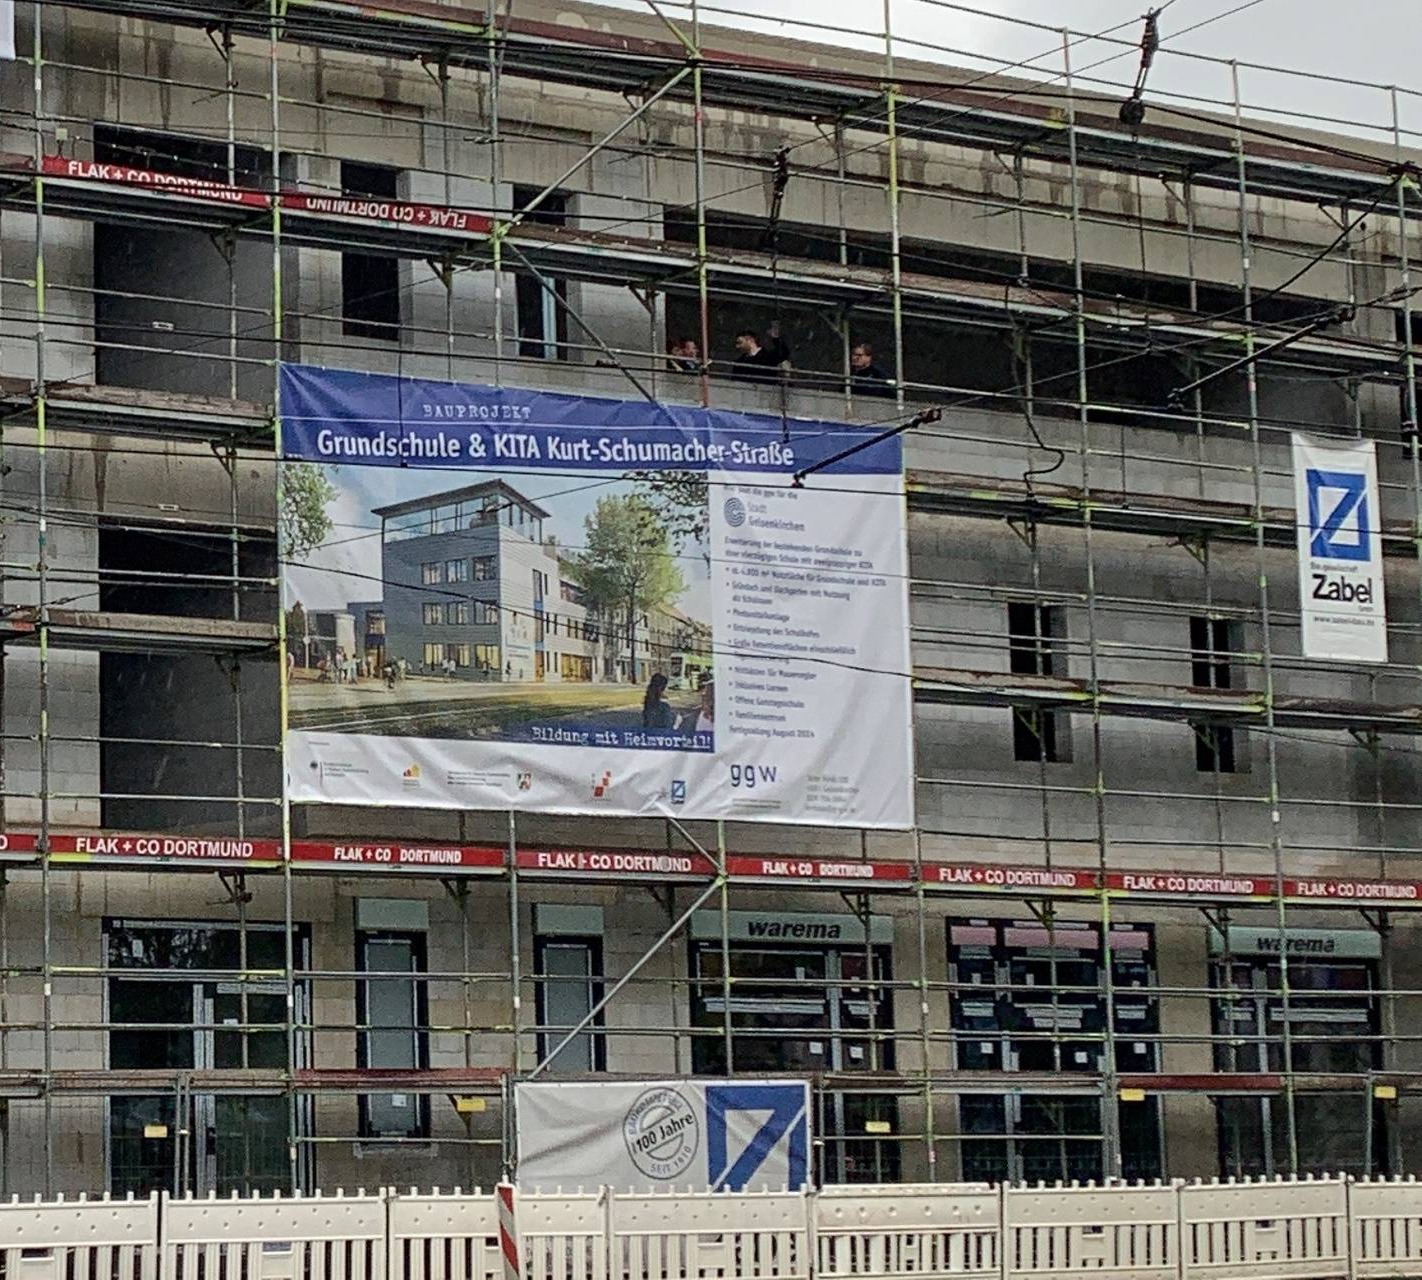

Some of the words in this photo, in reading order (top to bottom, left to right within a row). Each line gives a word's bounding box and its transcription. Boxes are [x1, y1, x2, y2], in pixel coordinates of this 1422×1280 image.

[68, 161, 109, 180] FLAK
[114, 168, 123, 178] +
[127, 170, 150, 183] CO
[306, 197, 389, 218] DORTMUND
[392, 206, 415, 222] CO
[429, 210, 467, 228] FLAK
[422, 403, 532, 420] BAUPROJEKT
[316, 429, 461, 458] Grundschule
[469, 434, 487, 457] &
[494, 435, 541, 459] KITA
[546, 435, 795, 466] Kurt-Schumacher-Straße
[1312, 573, 1373, 604] Zabel
[531, 726, 590, 747] Bildung
[595, 730, 619, 745] mit
[76, 837, 119, 854] FLAK
[122, 842, 132, 852] +
[135, 840, 160, 855] CO
[163, 840, 254, 858] DORTMUND
[334, 847, 363, 861] FLAK
[365, 850, 373, 858] +
[375, 849, 392, 861] CO
[399, 848, 462, 864] DORTMUND
[538, 853, 576, 869] FLAK
[589, 855, 611, 870] CO
[762, 861, 789, 875] FLAK
[790, 864, 797, 872] +
[798, 863, 813, 875] CO
[818, 864, 874, 878] DORTMUND
[939, 867, 972, 883] FLAK
[975, 872, 984, 881] +
[985, 870, 1003, 884] CO
[1005, 870, 1076, 887] DORTMUND
[1123, 875, 1155, 890] FLAK
[1157, 879, 1166, 889] +
[1168, 877, 1185, 891] CO
[1188, 877, 1254, 894] DORTMUND
[1297, 882, 1327, 896] FLAK
[1328, 885, 1336, 895] +
[1338, 883, 1355, 897] CO
[1356, 885, 1417, 899] DORTMUND
[748, 921, 841, 939] warema
[636, 1130, 658, 1152] 100
[658, 1113, 695, 1140] Jahre
[650, 1162, 671, 1175] SEIT
